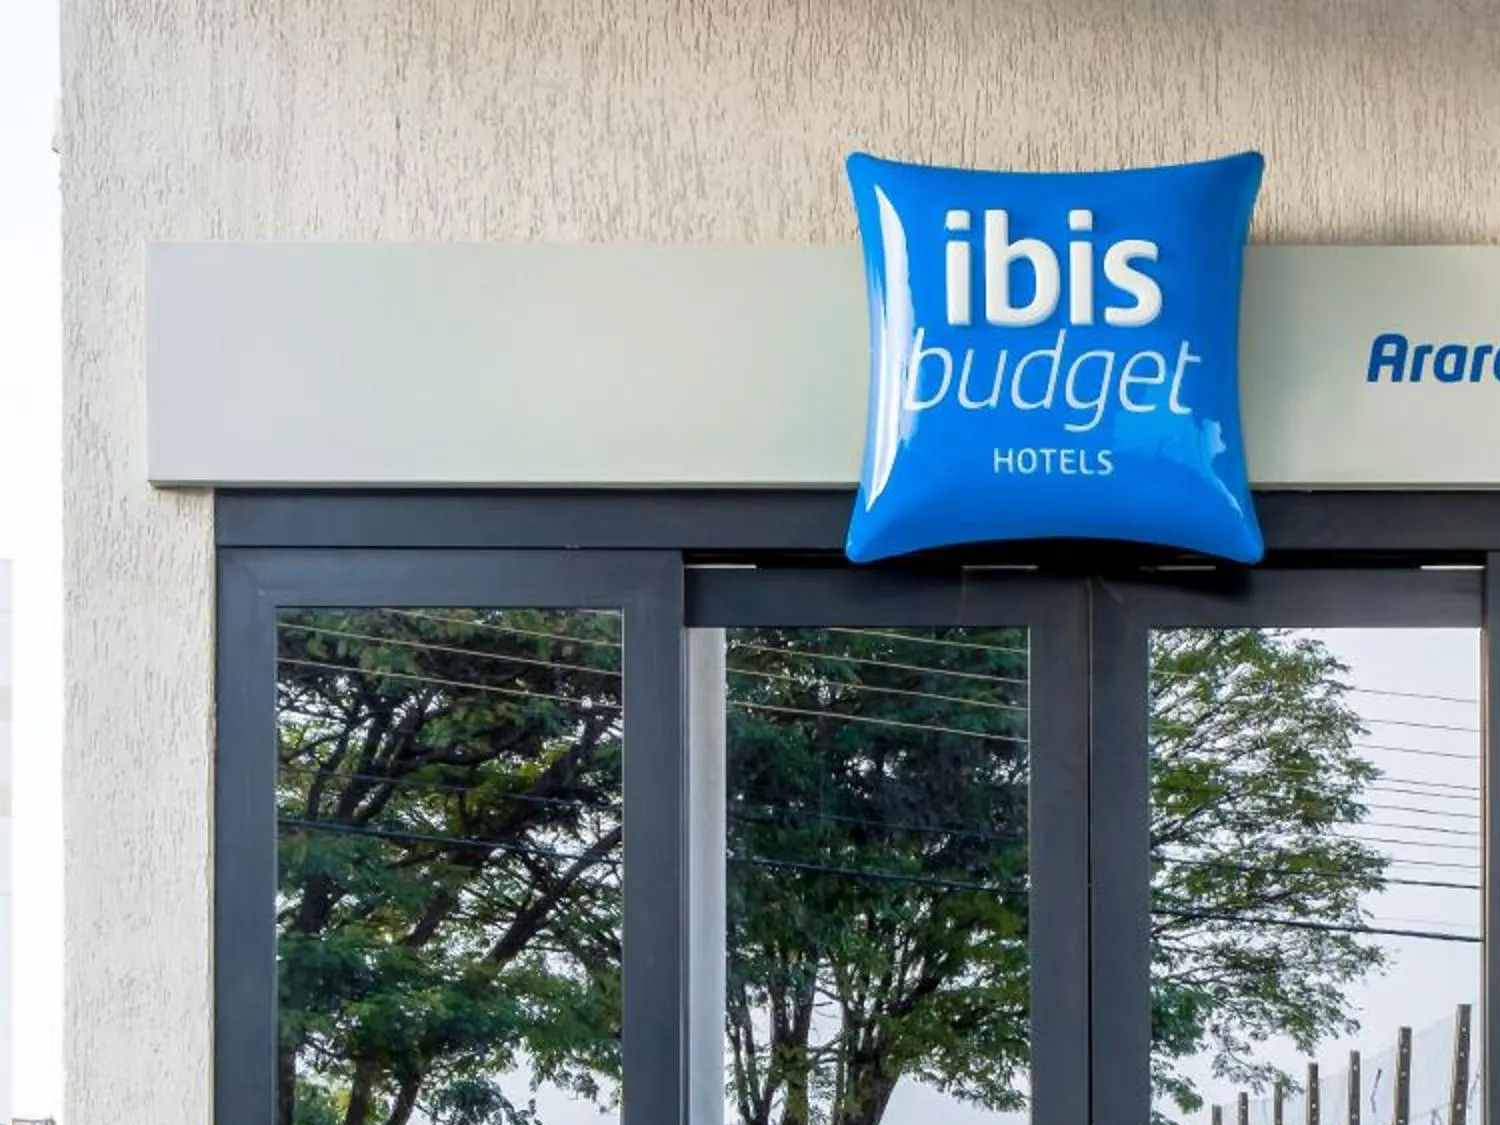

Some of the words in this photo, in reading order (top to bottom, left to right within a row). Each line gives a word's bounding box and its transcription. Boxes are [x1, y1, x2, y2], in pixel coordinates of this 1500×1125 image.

[944, 208, 1164, 328] ibis
[904, 327, 1201, 432] budget
[993, 447, 1115, 475] HOTELS
